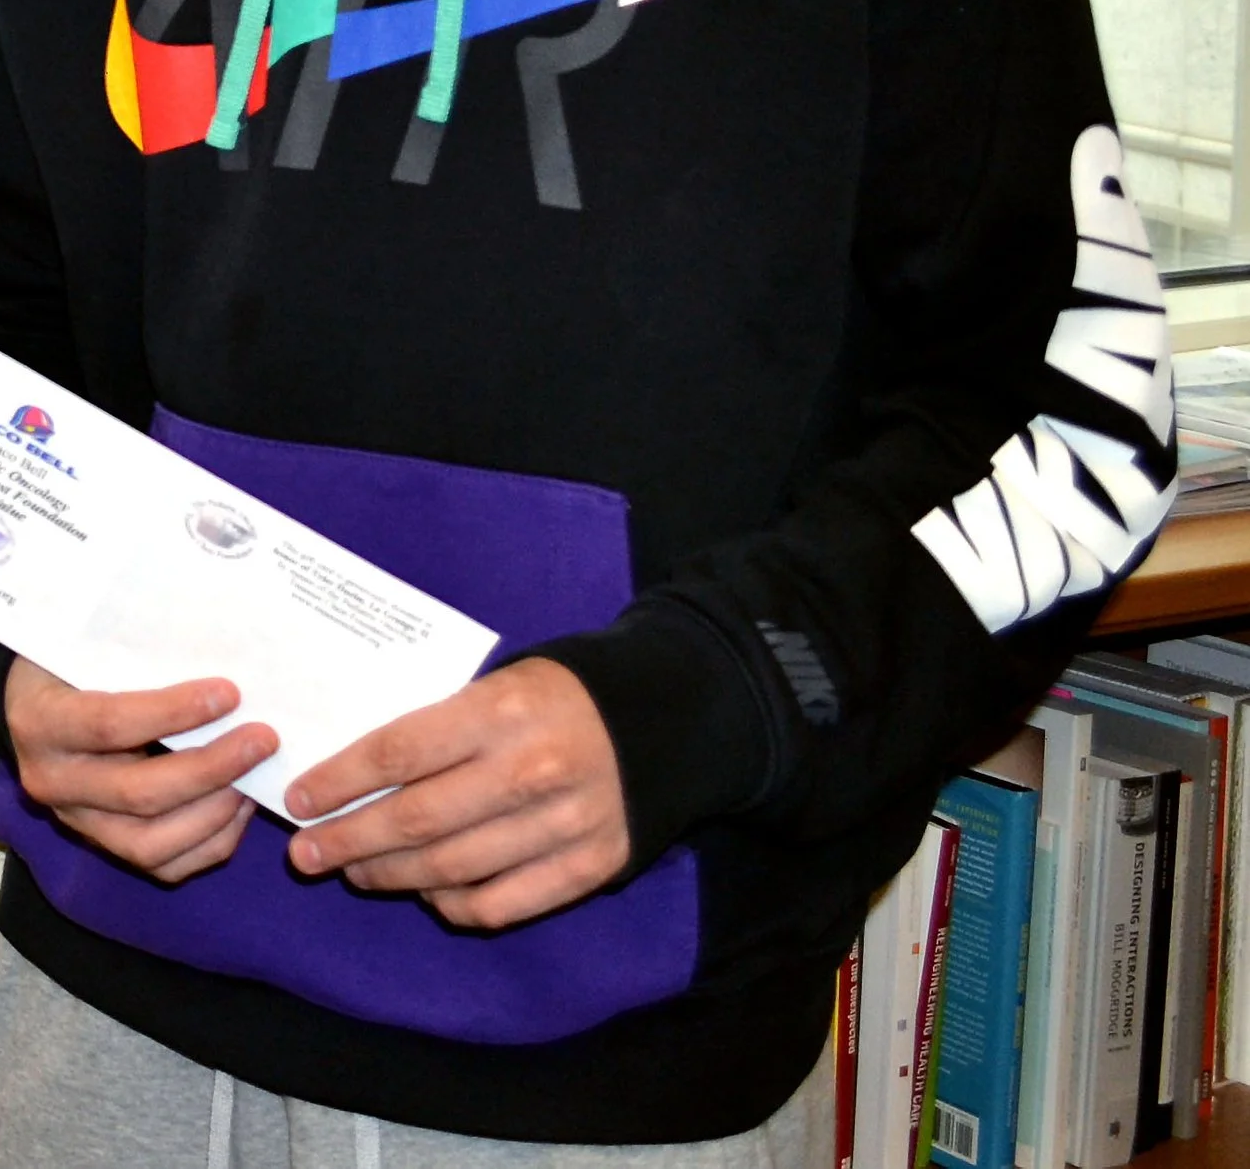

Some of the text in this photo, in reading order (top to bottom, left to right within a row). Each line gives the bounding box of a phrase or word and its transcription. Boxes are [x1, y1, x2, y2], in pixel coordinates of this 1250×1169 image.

[19, 457, 49, 480] Bell
[25, 441, 80, 482] BELL
[9, 470, 71, 514] Oncology
[12, 490, 88, 543] Foundation
[1122, 841, 1146, 1039] DESIGNING INTERACTIONS
[1108, 923, 1125, 1040] BILL MOGGRIDGE
[910, 927, 947, 1128] REENGINEERING HEALTH CARE
